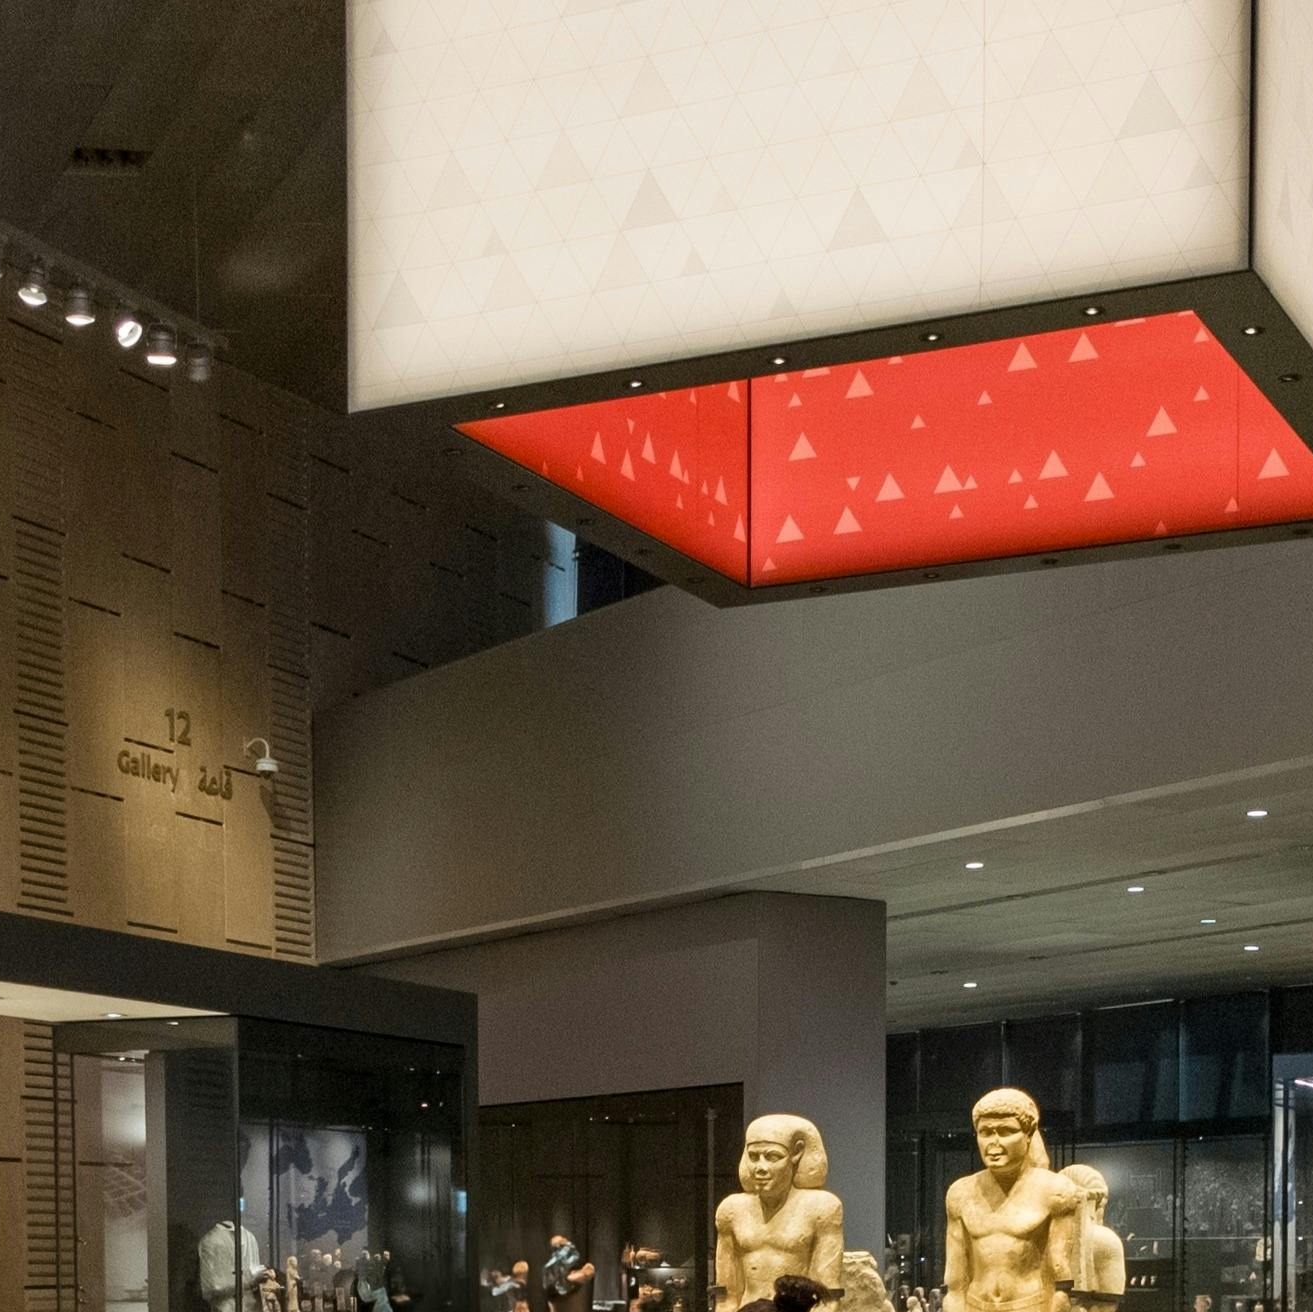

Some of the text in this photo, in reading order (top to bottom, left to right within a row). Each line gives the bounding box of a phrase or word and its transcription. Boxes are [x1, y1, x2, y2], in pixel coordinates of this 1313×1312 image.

[164, 707, 191, 746] 12
[117, 750, 179, 793] Gallery
[198, 766, 233, 800] قاعة
